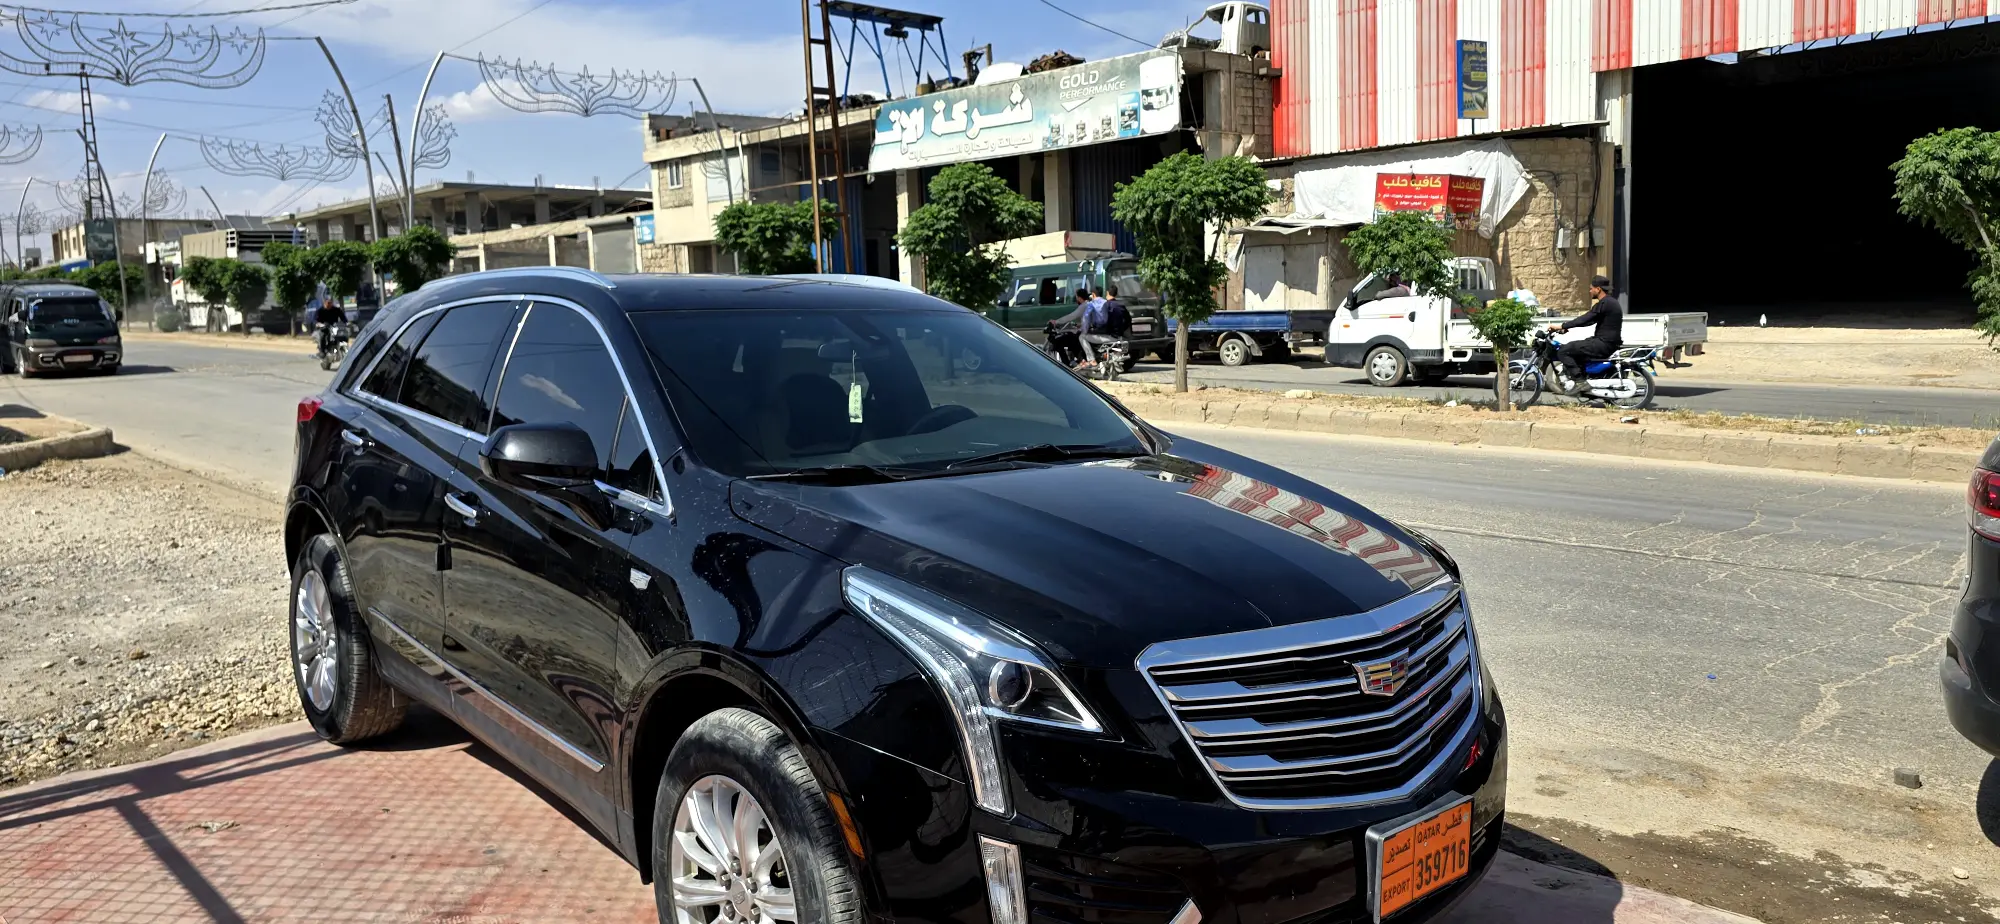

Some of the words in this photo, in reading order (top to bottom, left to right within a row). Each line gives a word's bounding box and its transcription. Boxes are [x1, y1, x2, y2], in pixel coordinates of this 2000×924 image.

[1060, 70, 1099, 89] GOLD
[1060, 80, 1127, 99] PERFORMANCE
[931, 82, 1034, 140] شركة
[875, 106, 925, 155] الإت
[1383, 175, 1408, 189] حلب
[1409, 175, 1442, 190] كافيه
[1452, 178, 1465, 191] حلب
[1441, 807, 1462, 836] قطر
[1417, 823, 1440, 844] QATAR
[1386, 838, 1411, 864] تصدير
[1416, 837, 1466, 891] 359716
[1383, 878, 1410, 903] EXPORT
